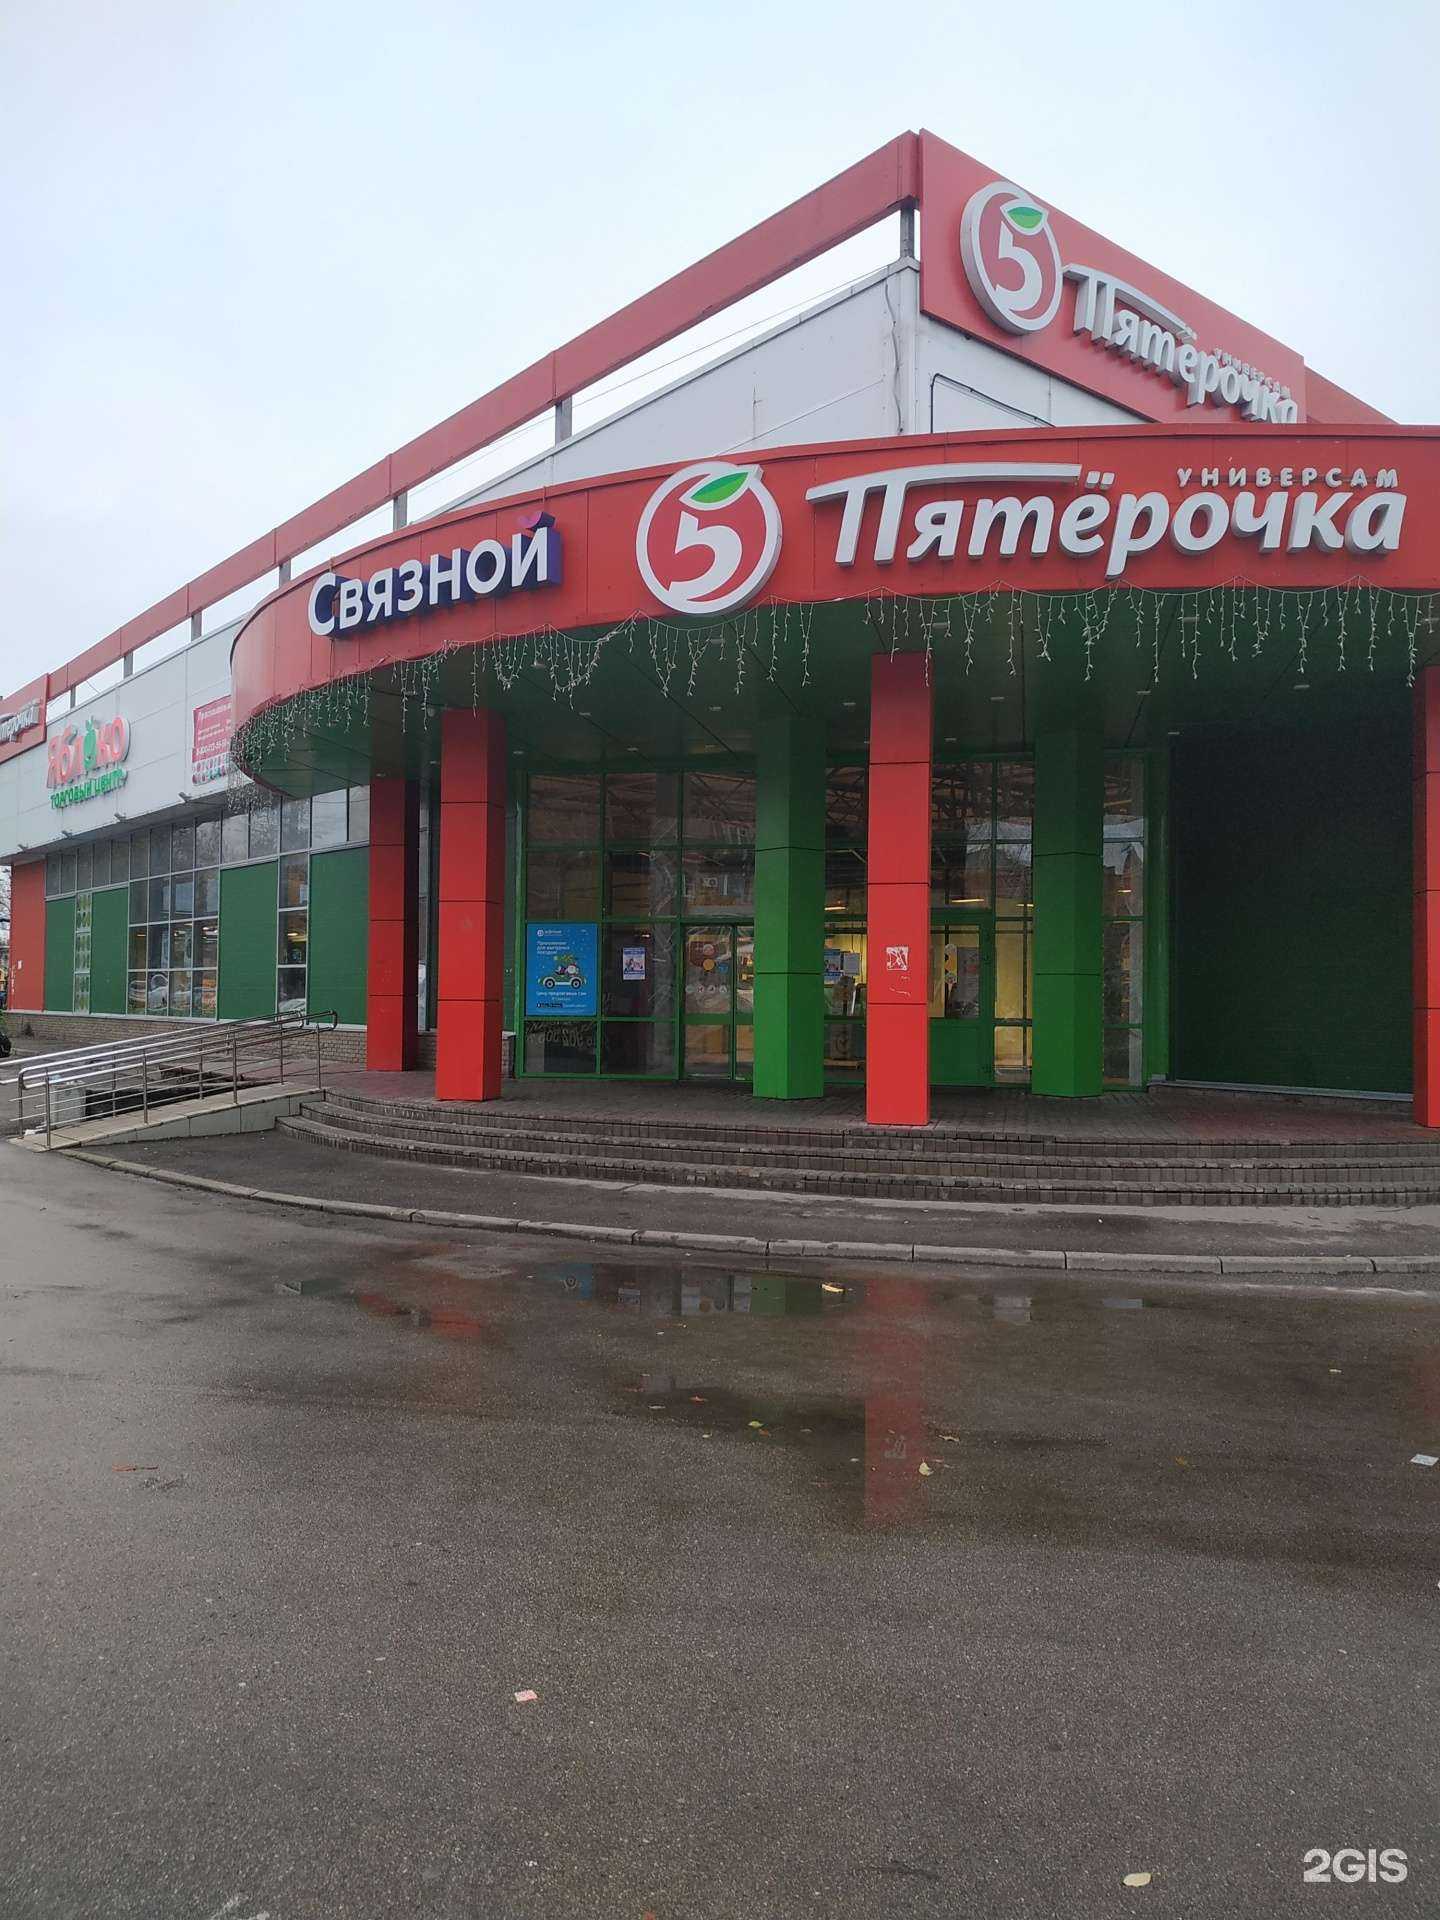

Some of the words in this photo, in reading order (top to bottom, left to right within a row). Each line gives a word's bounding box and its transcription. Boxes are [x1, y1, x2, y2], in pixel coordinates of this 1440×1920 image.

[805, 462, 1408, 579] Пятёрочка
[1176, 467, 1399, 488] УНИВЕРСАМ
[307, 511, 558, 638] Связной
[668, 510, 743, 604] 5
